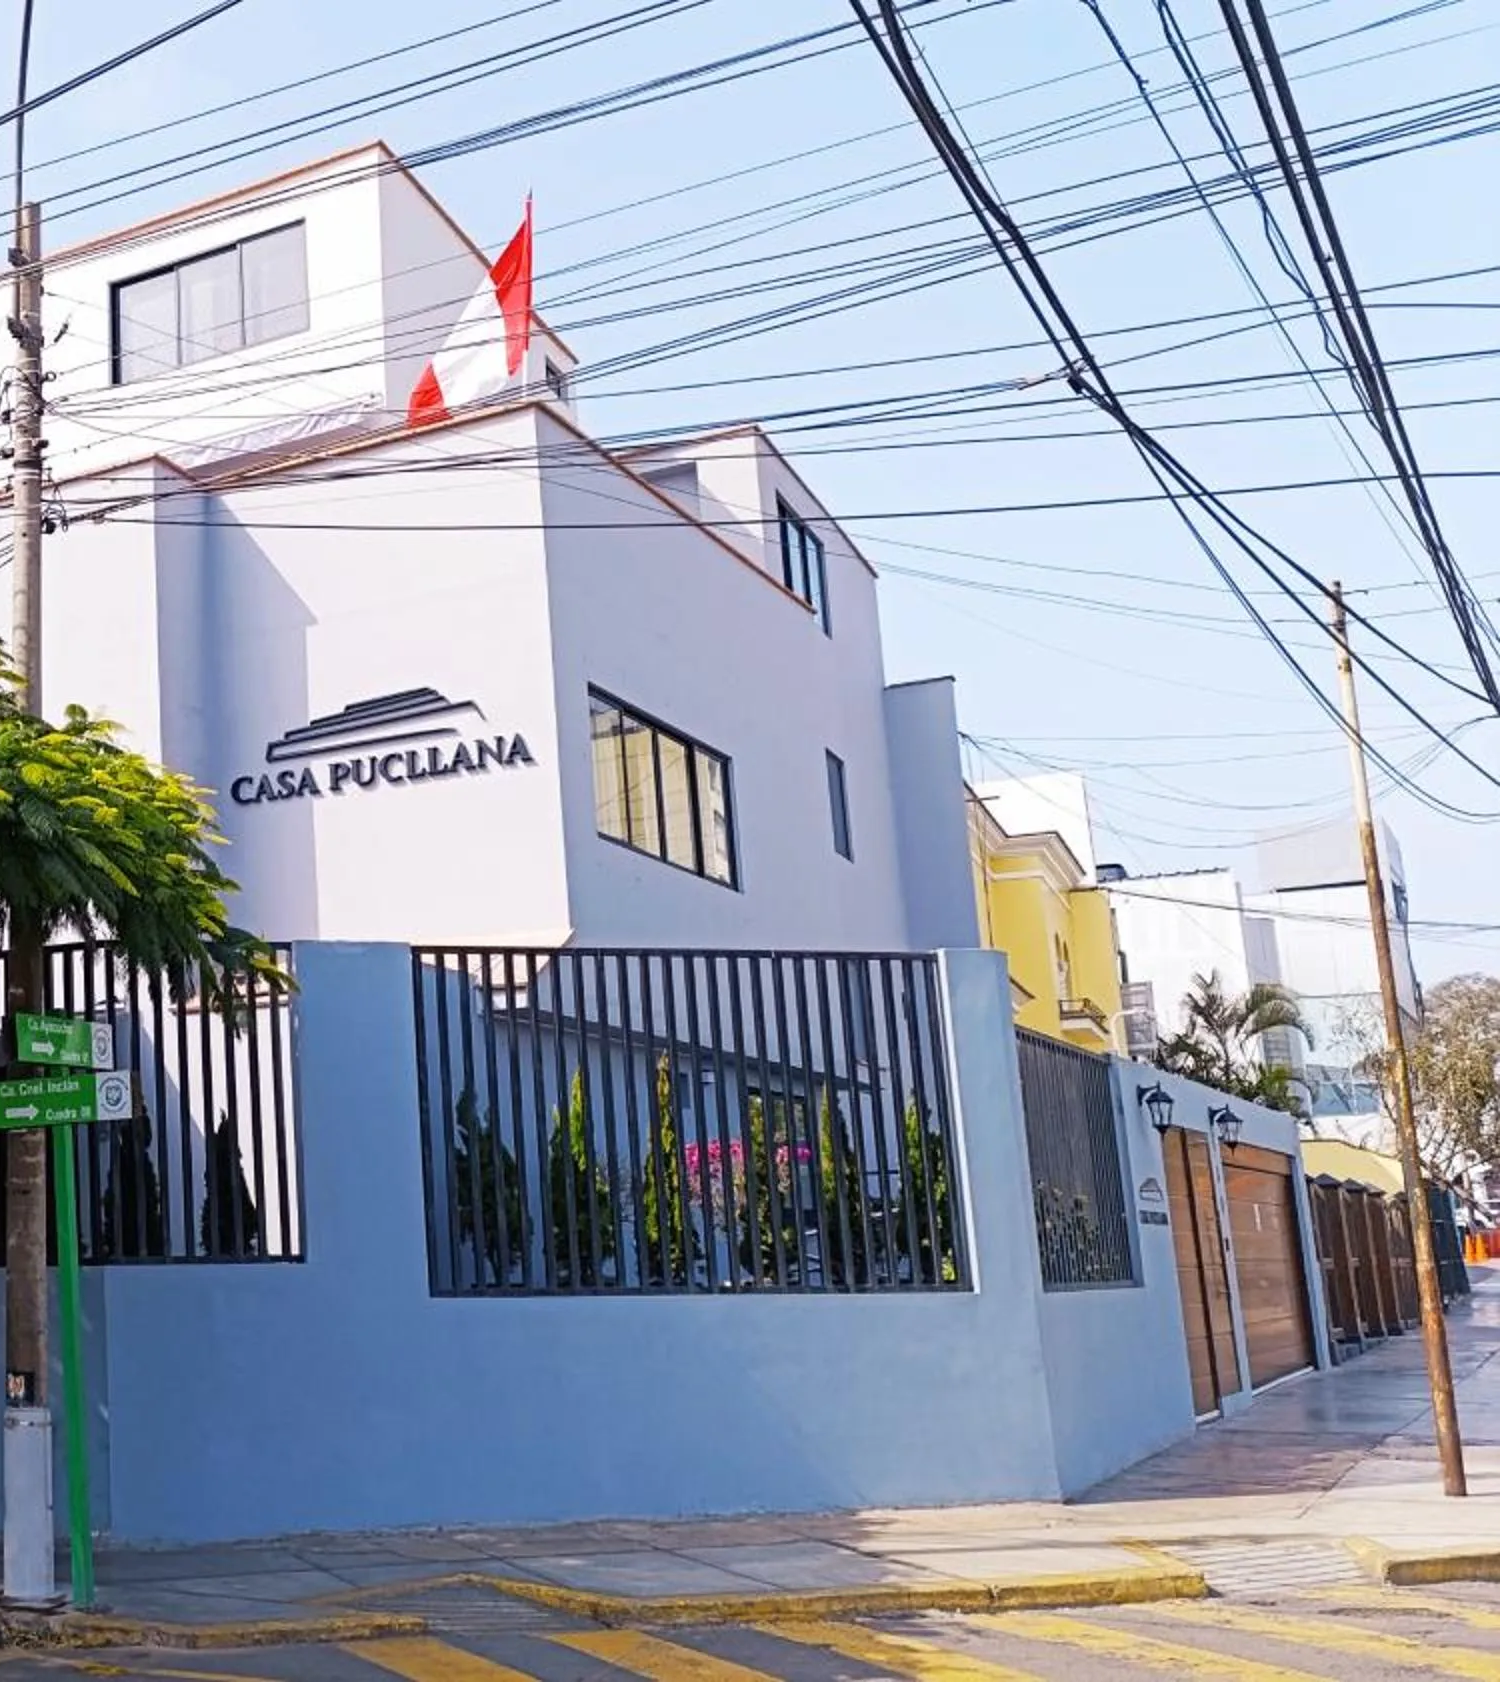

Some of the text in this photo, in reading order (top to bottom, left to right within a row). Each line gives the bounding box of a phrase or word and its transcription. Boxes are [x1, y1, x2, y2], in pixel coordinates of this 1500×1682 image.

[230, 732, 535, 805] CASA PUCLLANA
[45, 1106, 77, 1121] Cuadra
